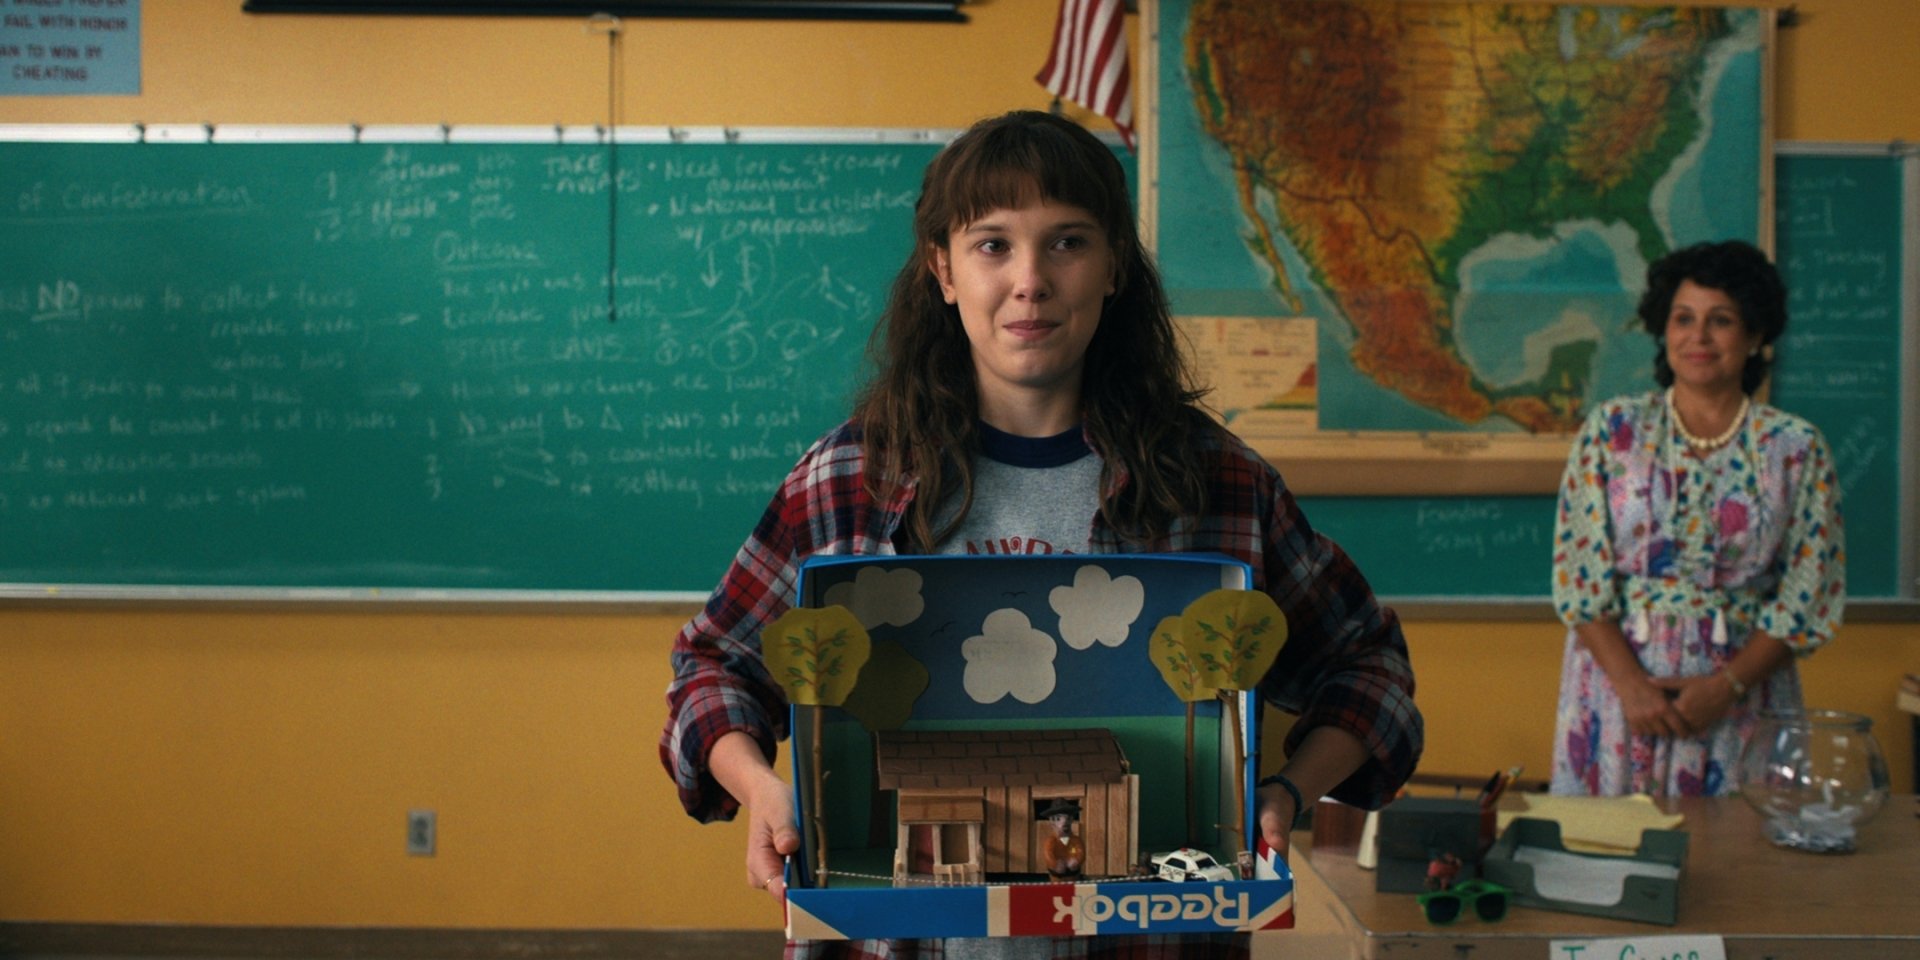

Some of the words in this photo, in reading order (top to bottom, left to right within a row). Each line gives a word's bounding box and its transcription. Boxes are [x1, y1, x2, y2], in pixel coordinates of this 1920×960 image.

[39, 14, 76, 29] WITH
[80, 16, 128, 31] HONOR
[27, 43, 46, 58] TO
[51, 44, 79, 58] WIN
[84, 44, 102, 58] BY
[12, 63, 88, 81] CHEATING
[542, 153, 603, 178] TAKE
[17, 181, 45, 212] of
[1052, 885, 1250, 929] Reebok
